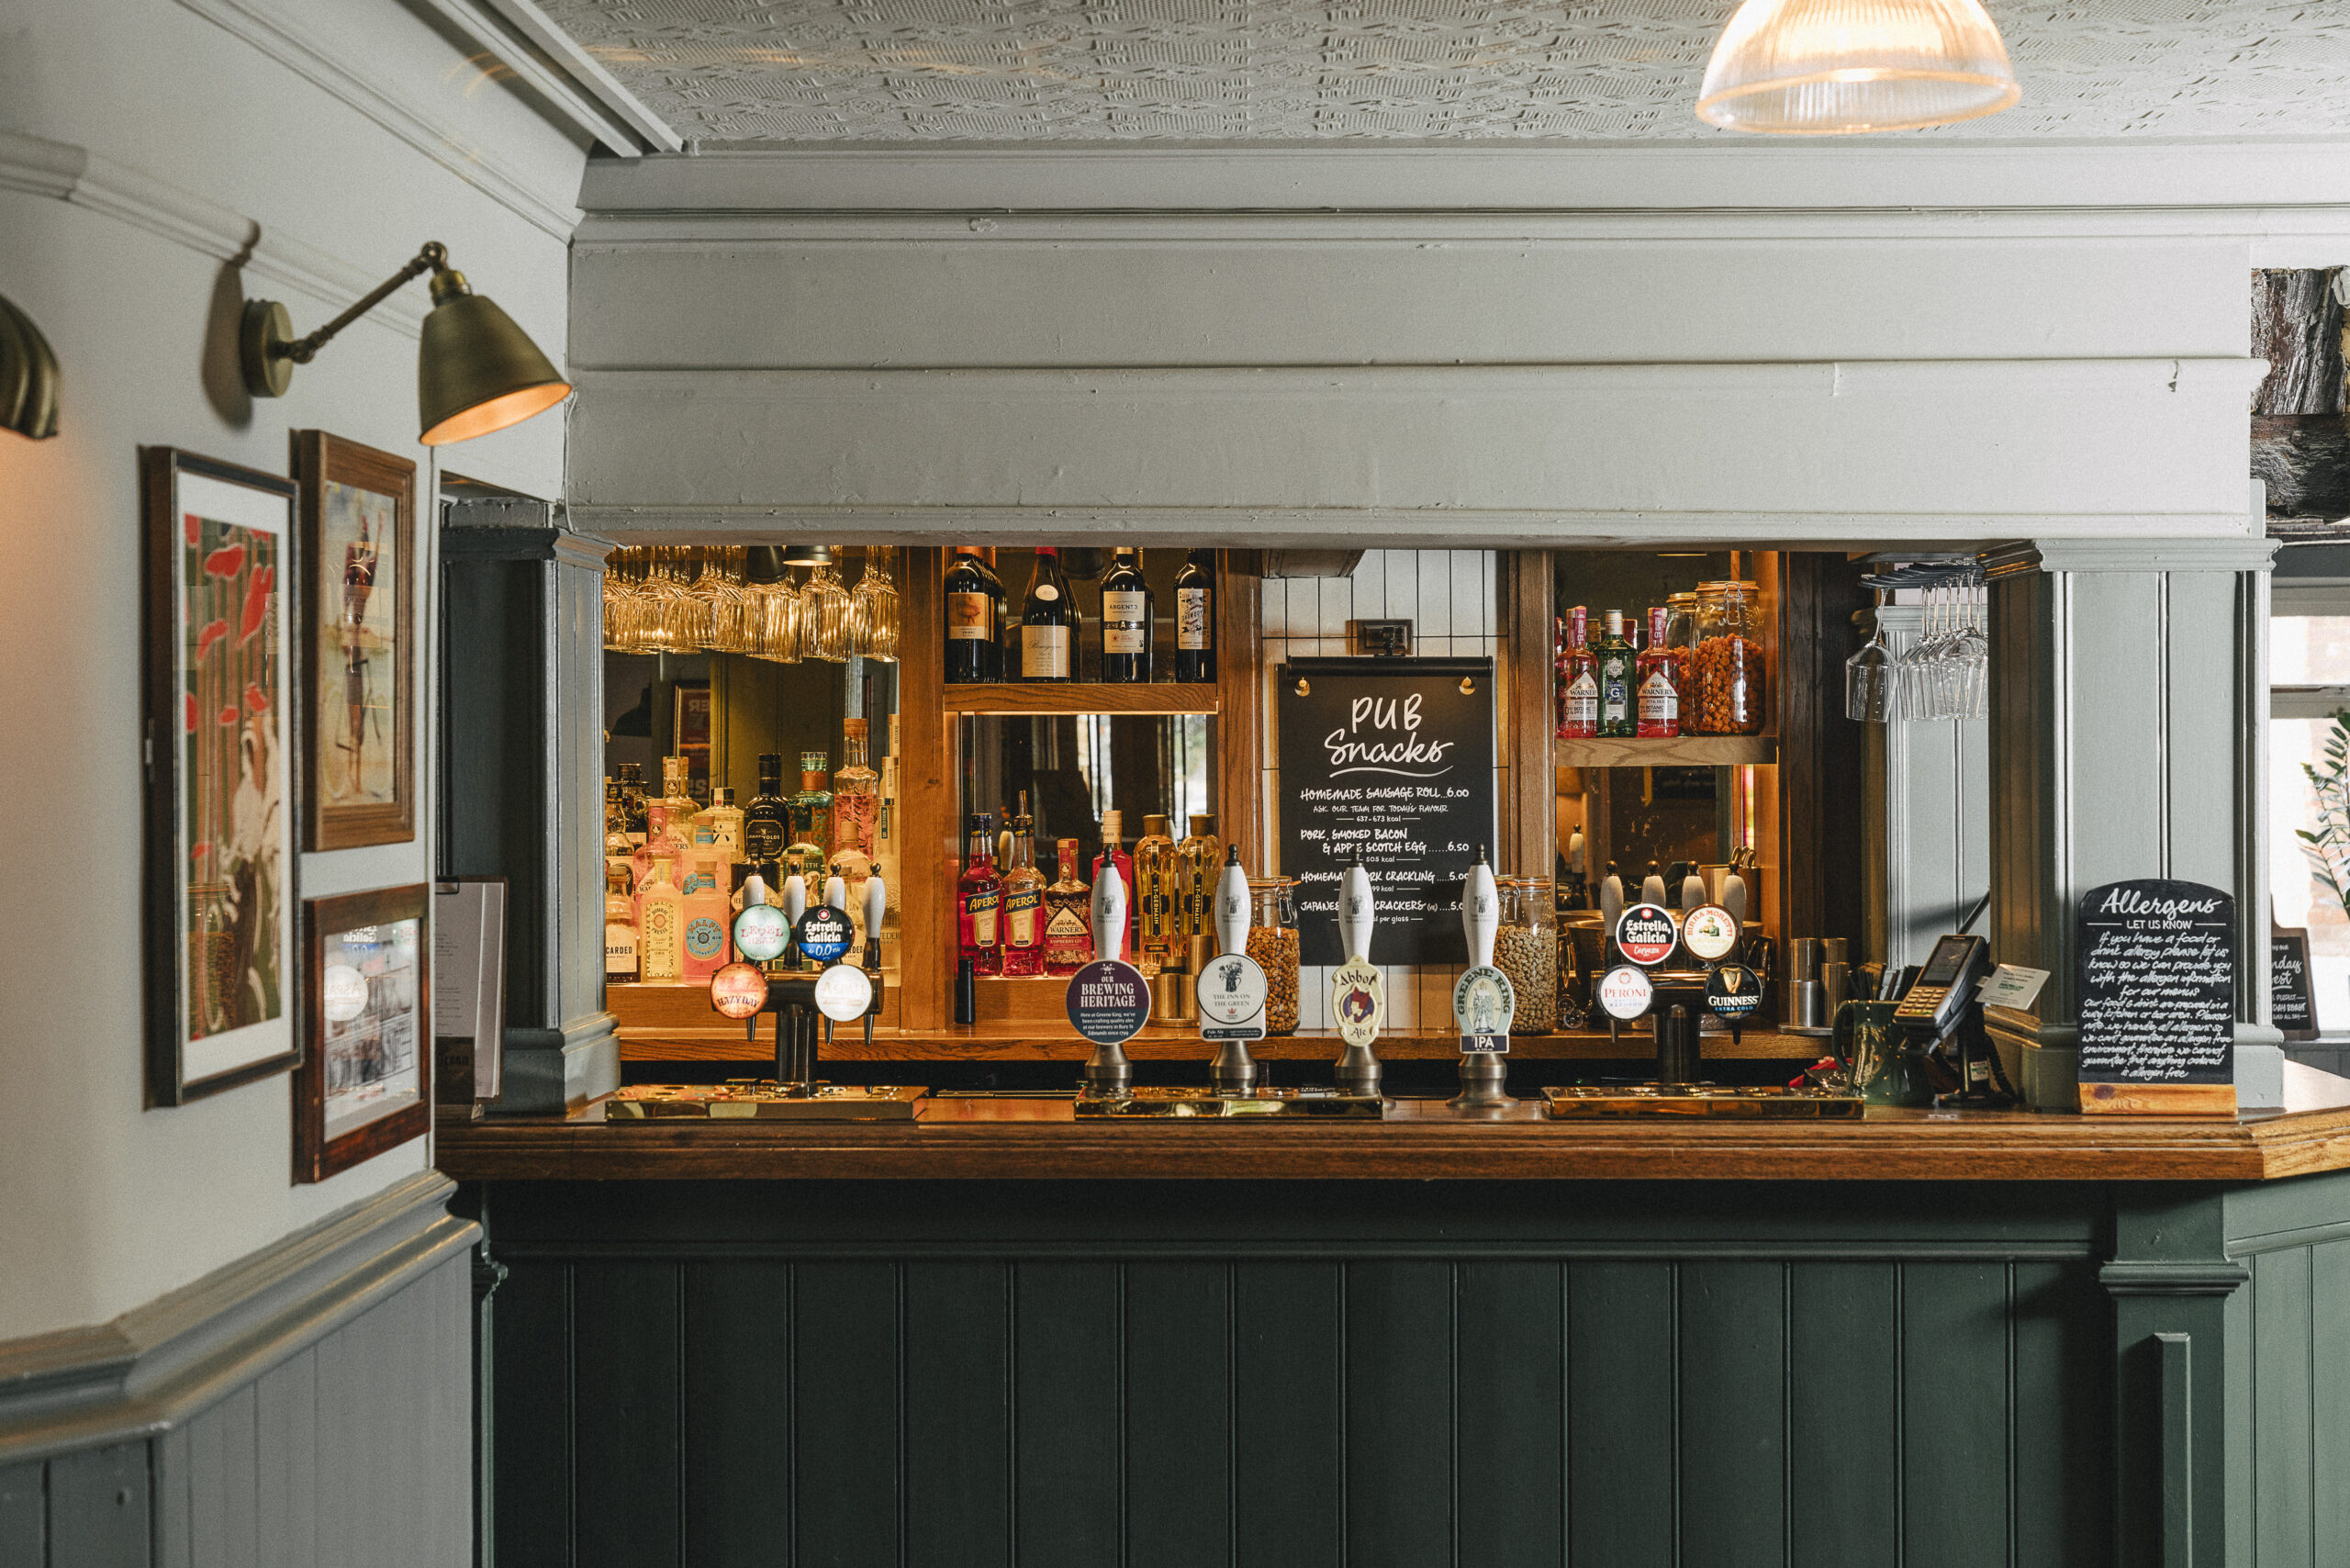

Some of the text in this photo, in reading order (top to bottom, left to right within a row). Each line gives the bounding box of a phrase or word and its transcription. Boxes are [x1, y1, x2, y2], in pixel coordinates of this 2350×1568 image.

[1610, 688, 1620, 698] G
[1351, 692, 1422, 734] PUB
[1324, 728, 1454, 766] Snacks
[1300, 787, 1469, 801] HOMEMADE SAUSAGE ROLL 6.00
[1313, 805, 1328, 813] ASK
[1350, 805, 1370, 813] TEAM
[1372, 805, 1386, 813] FOR
[1388, 803, 1416, 813] TODAY'S
[1419, 804, 1449, 813] FLAVOUR
[1301, 827, 1408, 841] PORK, SMOKED BACON
[1366, 841, 1403, 853] SCOTCH
[1404, 841, 1427, 855] EGG
[1448, 841, 1469, 851] 6.50
[1385, 870, 1435, 884] CRACKLING
[1005, 894, 1038, 912] APEROL
[1374, 900, 1427, 912] CRACKERS
[2099, 888, 2222, 920] Allergens
[1380, 915, 1409, 924] per glass
[1626, 919, 1668, 932] Estrella
[1707, 910, 1733, 937] MORETTI
[2126, 920, 2193, 929] LET US KNOW
[688, 920, 721, 934] MALFY
[805, 921, 843, 933] Estrella
[806, 932, 841, 943] Galicia
[1627, 931, 1667, 944] Galicia
[2110, 935, 2132, 945] you
[2132, 932, 2164, 943] have
[2165, 935, 2175, 944] a
[2173, 932, 2208, 949] food
[815, 944, 832, 957] 0,0
[2090, 944, 2121, 956] drink
[2123, 944, 2161, 959] allergy
[2160, 946, 2200, 959] please
[2214, 948, 2230, 958] us
[2088, 958, 2118, 969] know
[2132, 961, 2151, 969] we
[2152, 960, 2171, 969] can
[2171, 958, 2212, 972] provide
[2210, 962, 2232, 974] you
[1340, 969, 1374, 986] Abbot
[2090, 969, 2232, 989] with the allergen information
[1081, 982, 1135, 995] BREWING
[1458, 968, 1511, 1015] GREENE KING
[1605, 988, 1646, 998] PERONI
[2119, 984, 2141, 1001] for
[2160, 987, 2200, 997] menus
[716, 995, 741, 1008] HAZY
[1080, 995, 1136, 1008] HERITAGE
[1708, 995, 1760, 1006] GUINNESS
[2084, 999, 2102, 1007] Our
[2100, 997, 2128, 1010] food
[2133, 998, 2159, 1008] drink
[2195, 1010, 2232, 1021] Please
[1351, 1027, 1367, 1038] Ale
[1474, 1036, 1494, 1048] IPA
[2129, 1066, 2164, 1081] allergen
[2165, 1066, 2189, 1080] free
